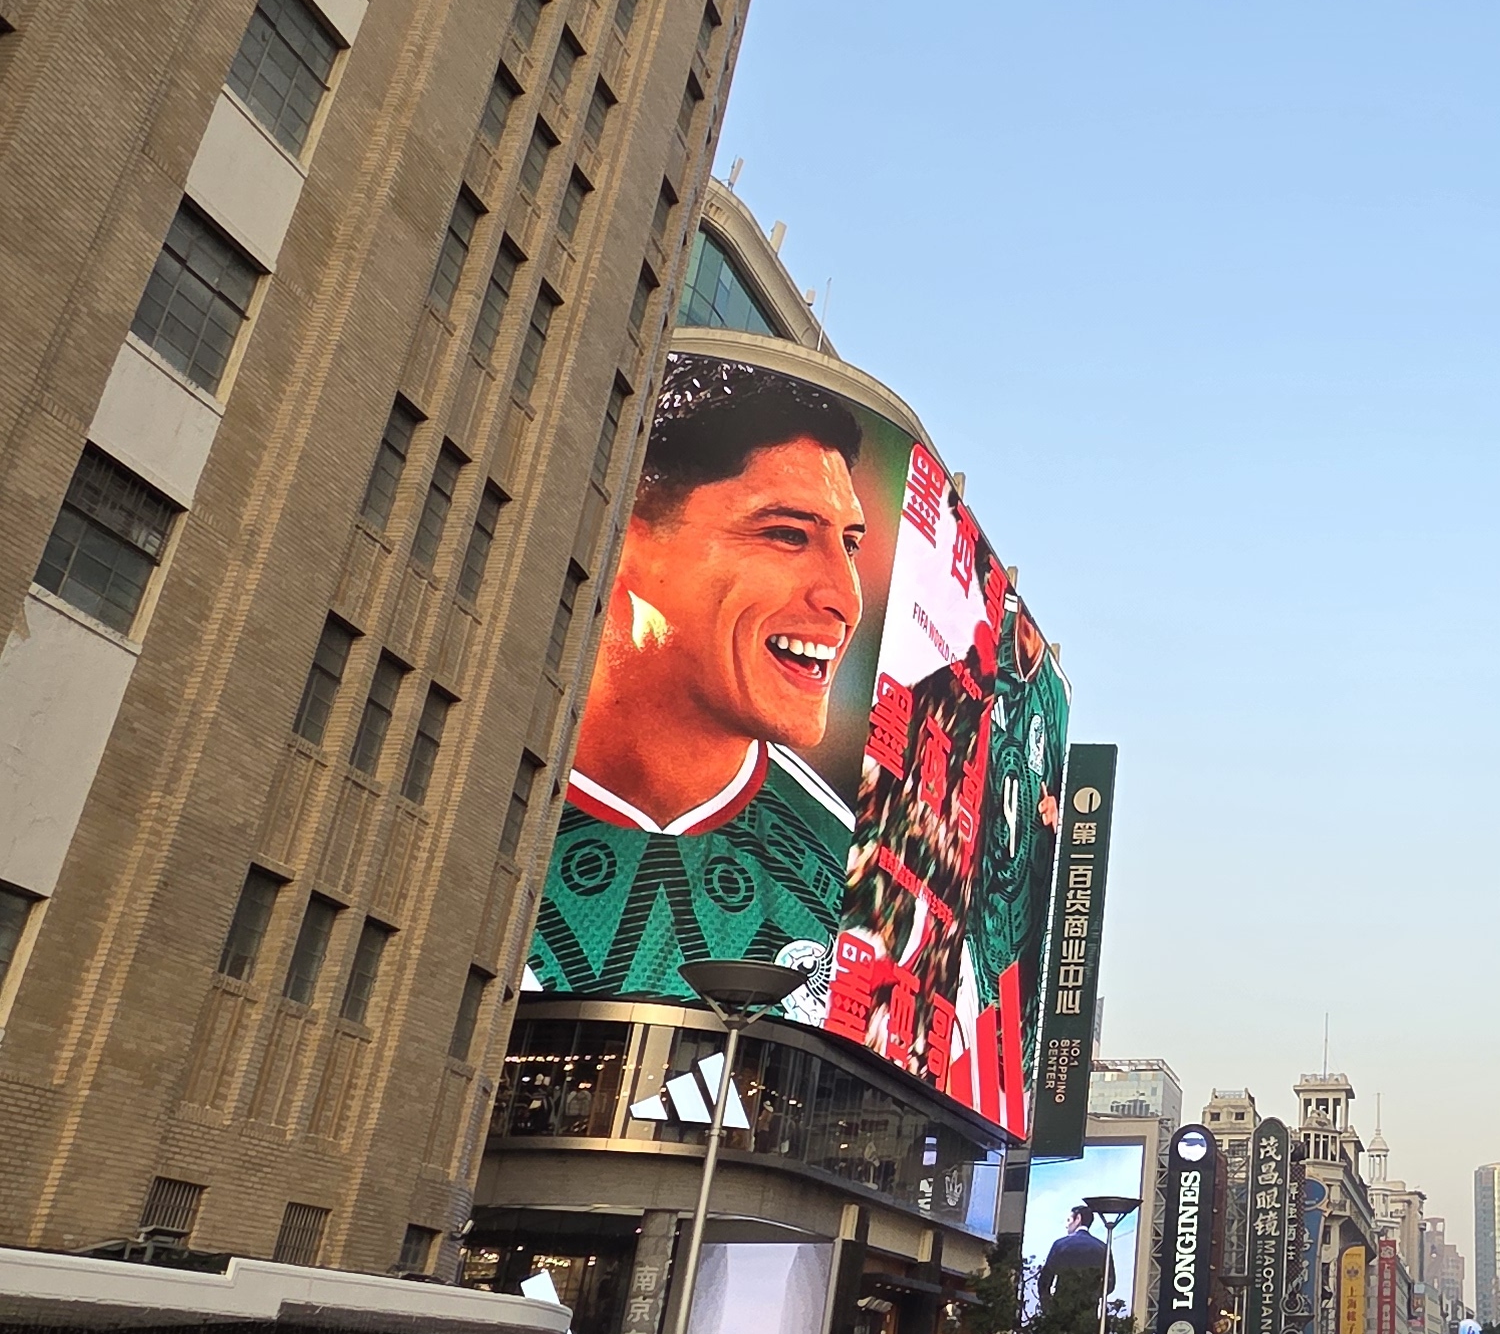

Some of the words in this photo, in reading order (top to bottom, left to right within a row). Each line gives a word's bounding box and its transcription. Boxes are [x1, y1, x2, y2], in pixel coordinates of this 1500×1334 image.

[913, 602, 928, 630] FIFA
[928, 621, 949, 663] WORLD
[1056, 822, 1097, 1015] 第一百货商业中心
[1045, 1039, 1059, 1090] CENTER
[1055, 1039, 1070, 1104] SHOPPING
[1071, 1039, 1081, 1067] NO.1
[1253, 1136, 1283, 1237] 茂昌眼镜
[1173, 1170, 1201, 1310] LONGINES
